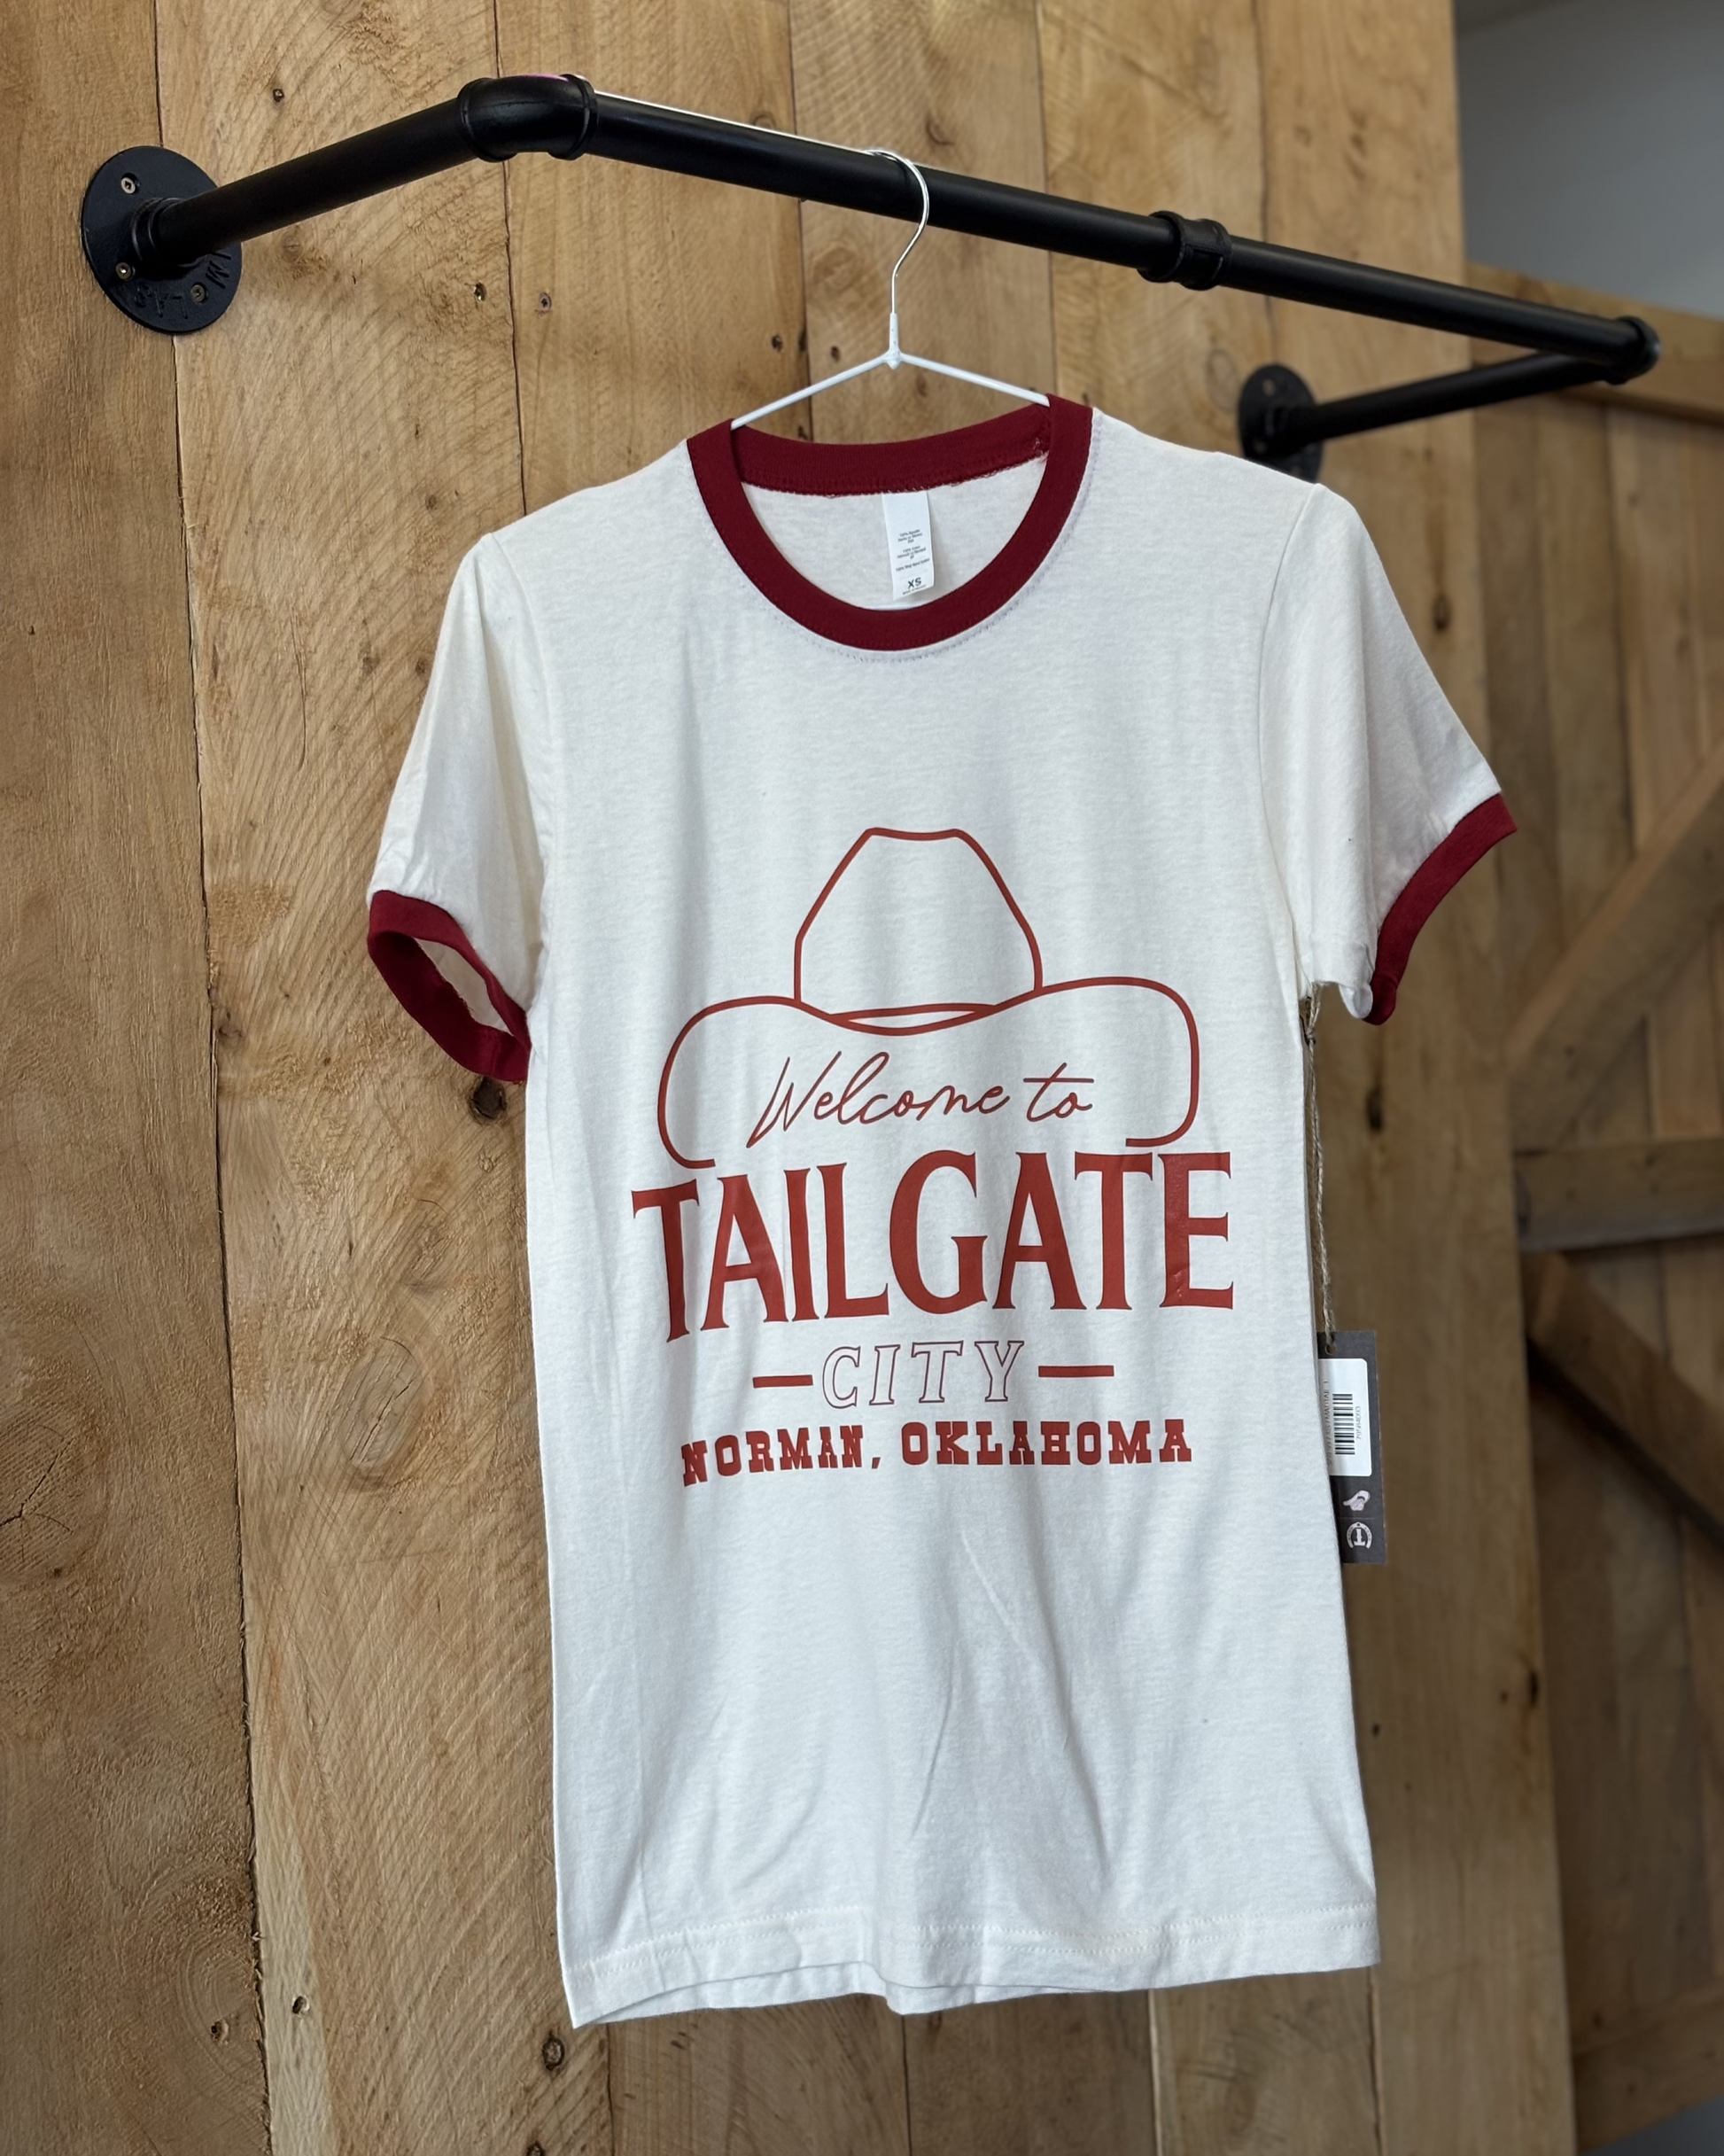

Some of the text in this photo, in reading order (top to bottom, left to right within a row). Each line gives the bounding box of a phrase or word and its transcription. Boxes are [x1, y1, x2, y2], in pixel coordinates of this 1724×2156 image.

[907, 577, 921, 589] XS
[746, 1050, 1095, 1148] Welcome to
[631, 1149, 1234, 1343] TAILGATE
[822, 1340, 1025, 1410] CITY
[681, 1419, 1192, 1487] NORMAN, OKLAHOMA
